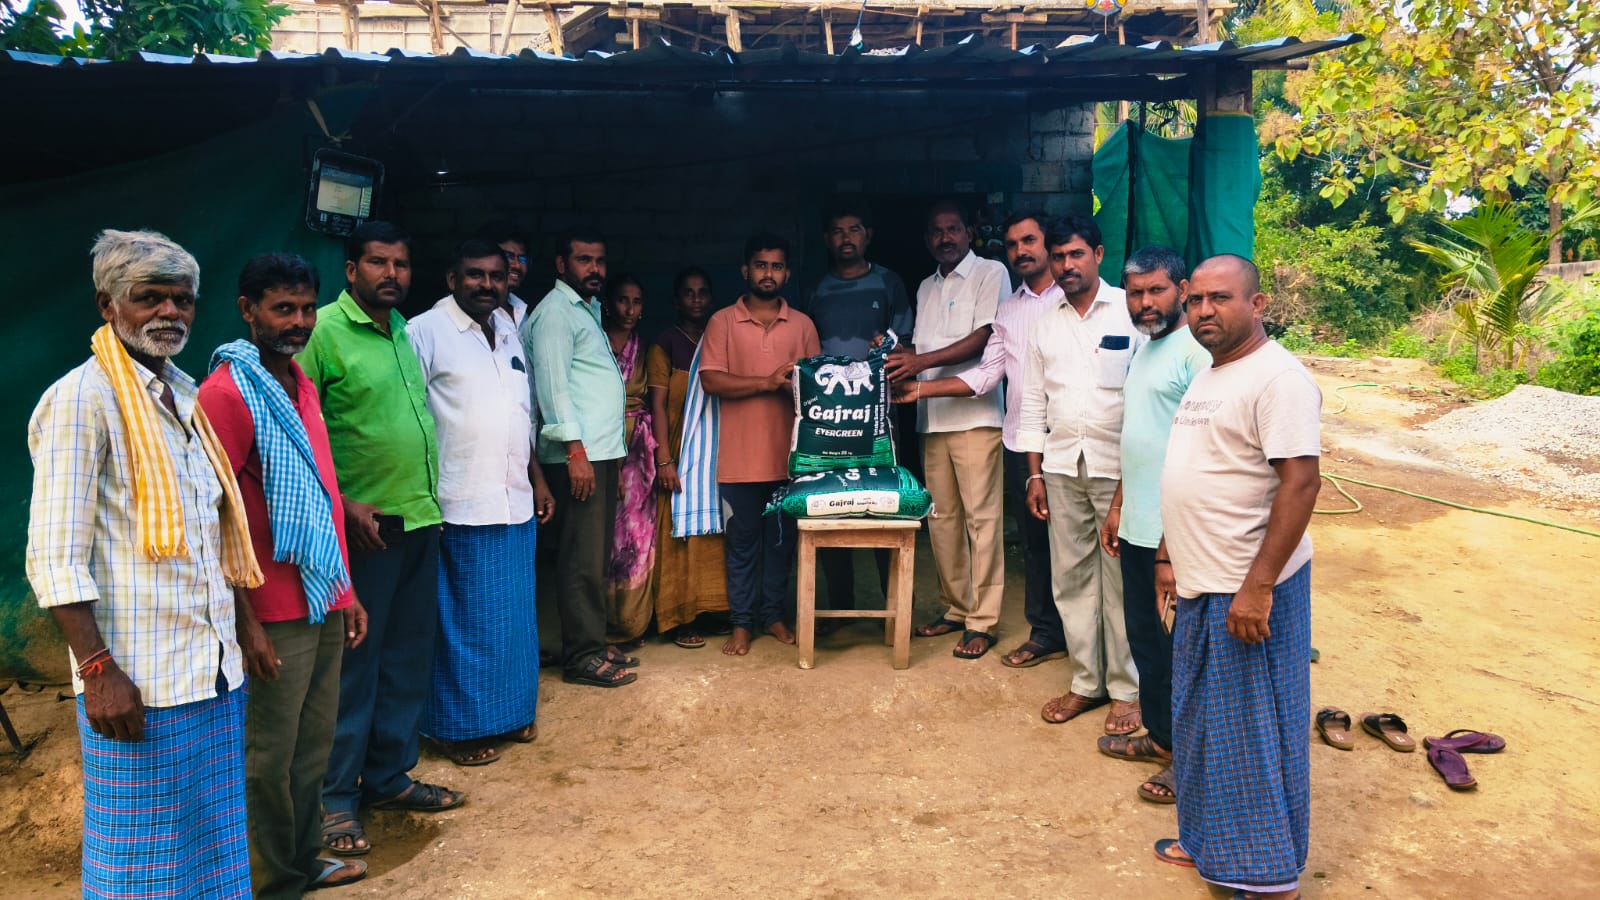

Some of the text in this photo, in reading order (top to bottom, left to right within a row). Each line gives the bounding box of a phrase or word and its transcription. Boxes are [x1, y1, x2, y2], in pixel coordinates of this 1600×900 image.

[808, 404, 871, 424] Gajraj
[815, 427, 864, 437] EVERGREEN
[829, 498, 855, 507] Gajraj
